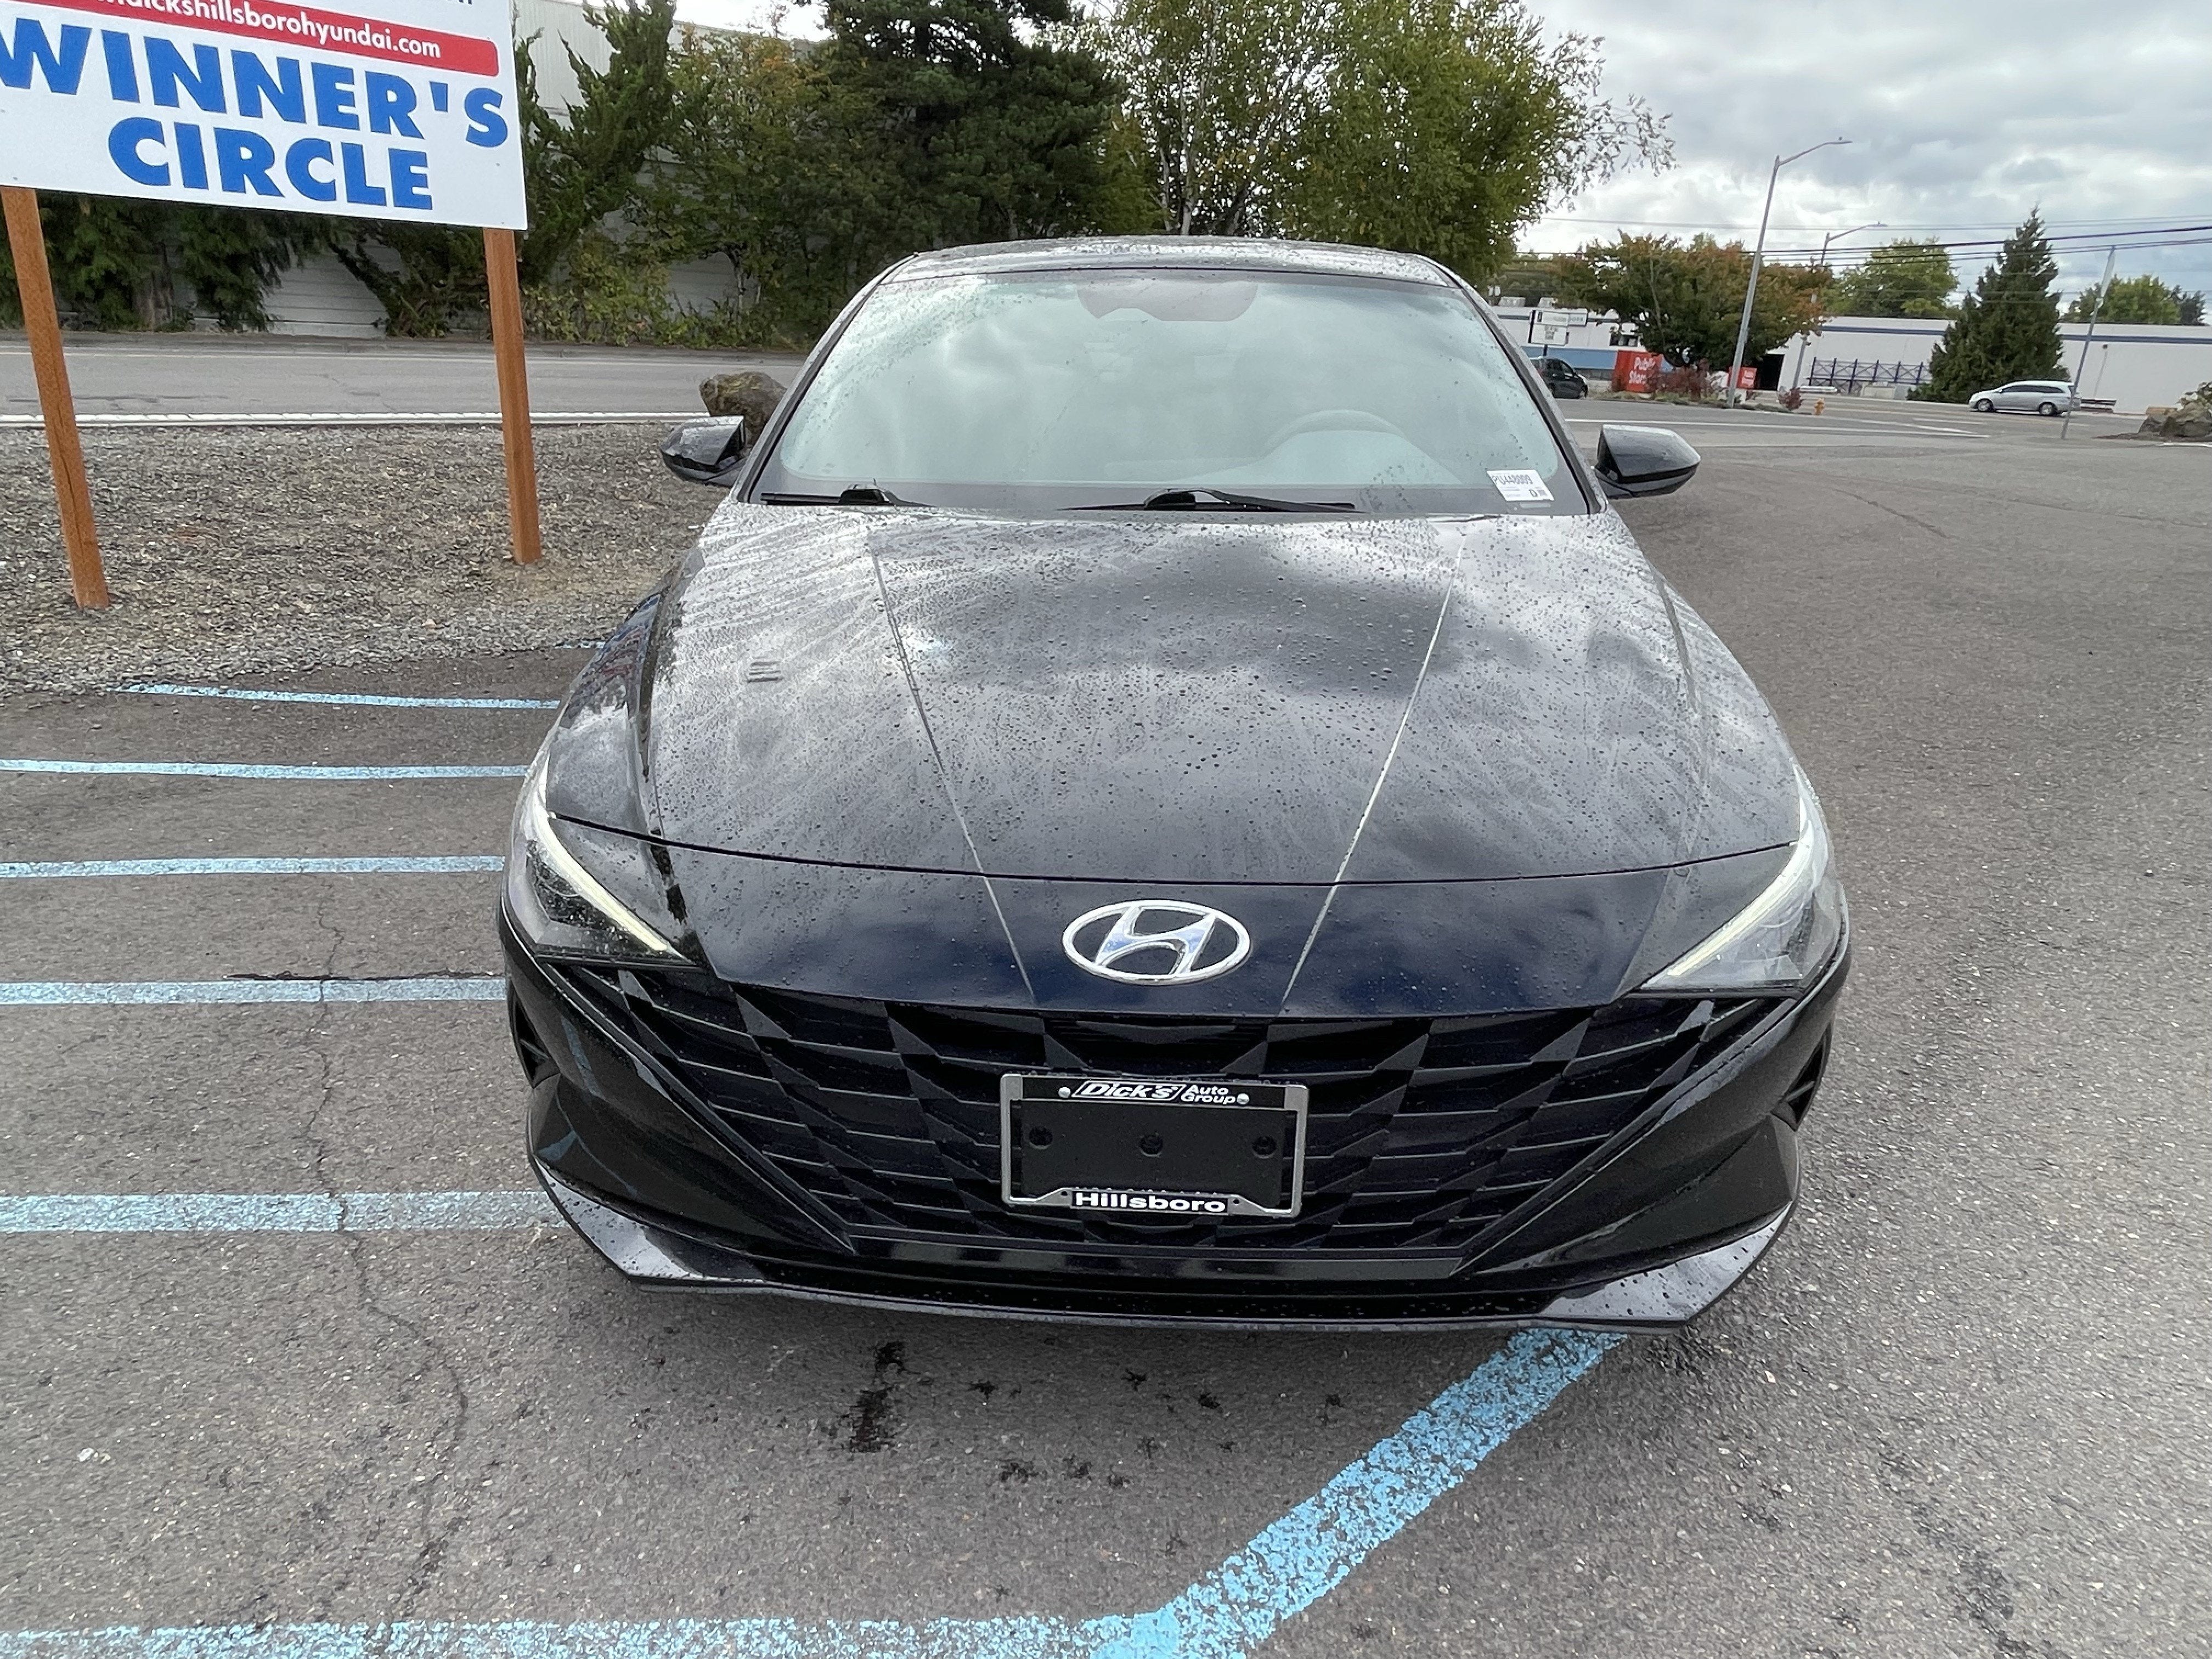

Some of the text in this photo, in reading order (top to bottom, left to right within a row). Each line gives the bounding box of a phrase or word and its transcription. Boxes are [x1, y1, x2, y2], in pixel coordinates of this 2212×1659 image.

[0, 18, 508, 148] WINNER'S
[109, 117, 432, 210] CIRCLE
[1181, 1092, 1235, 1105] Group
[1184, 1084, 1229, 1095] Auto
[1075, 1192, 1226, 1212] Hillsboro
